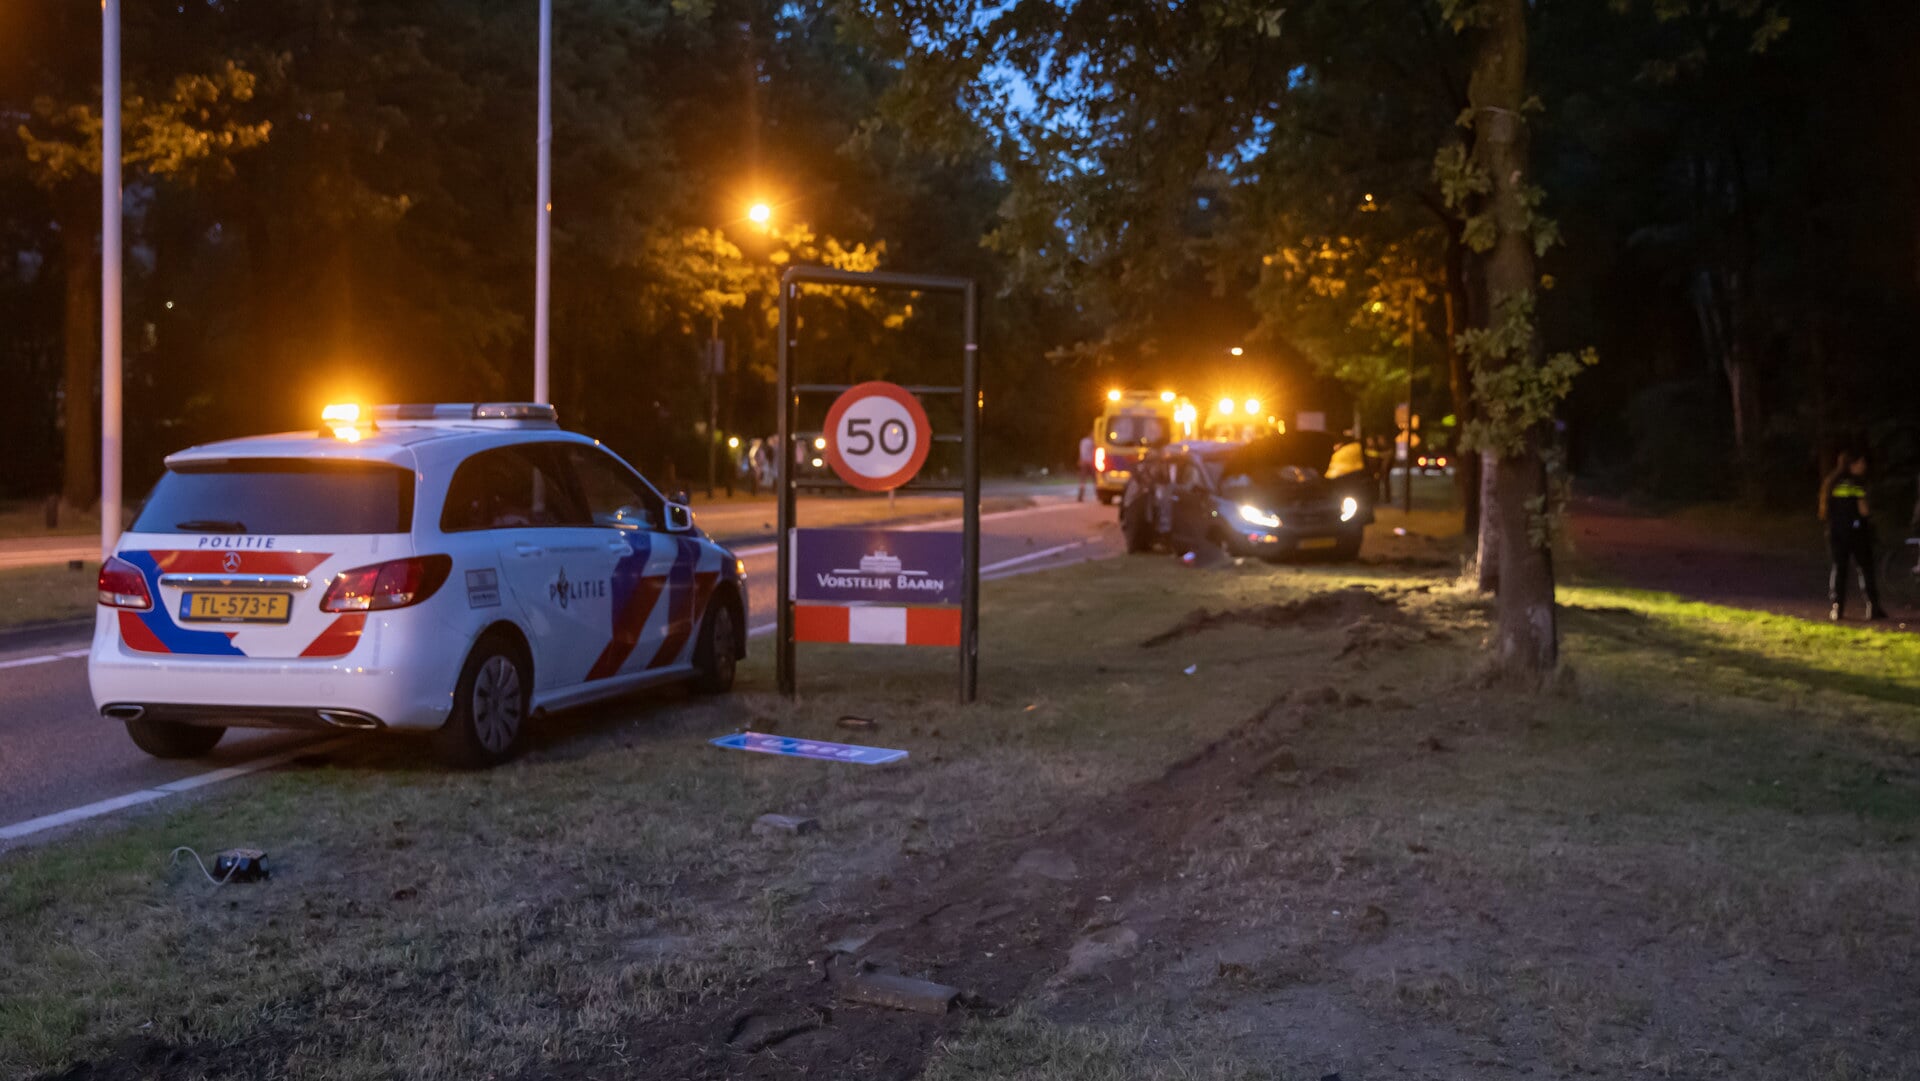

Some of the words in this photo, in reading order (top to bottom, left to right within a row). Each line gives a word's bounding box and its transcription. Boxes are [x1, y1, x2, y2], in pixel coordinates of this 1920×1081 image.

[846, 418, 909, 456] 50
[198, 536, 276, 549] POLITIE
[896, 574, 944, 591] BAARN
[200, 597, 278, 614] TL-573-F
